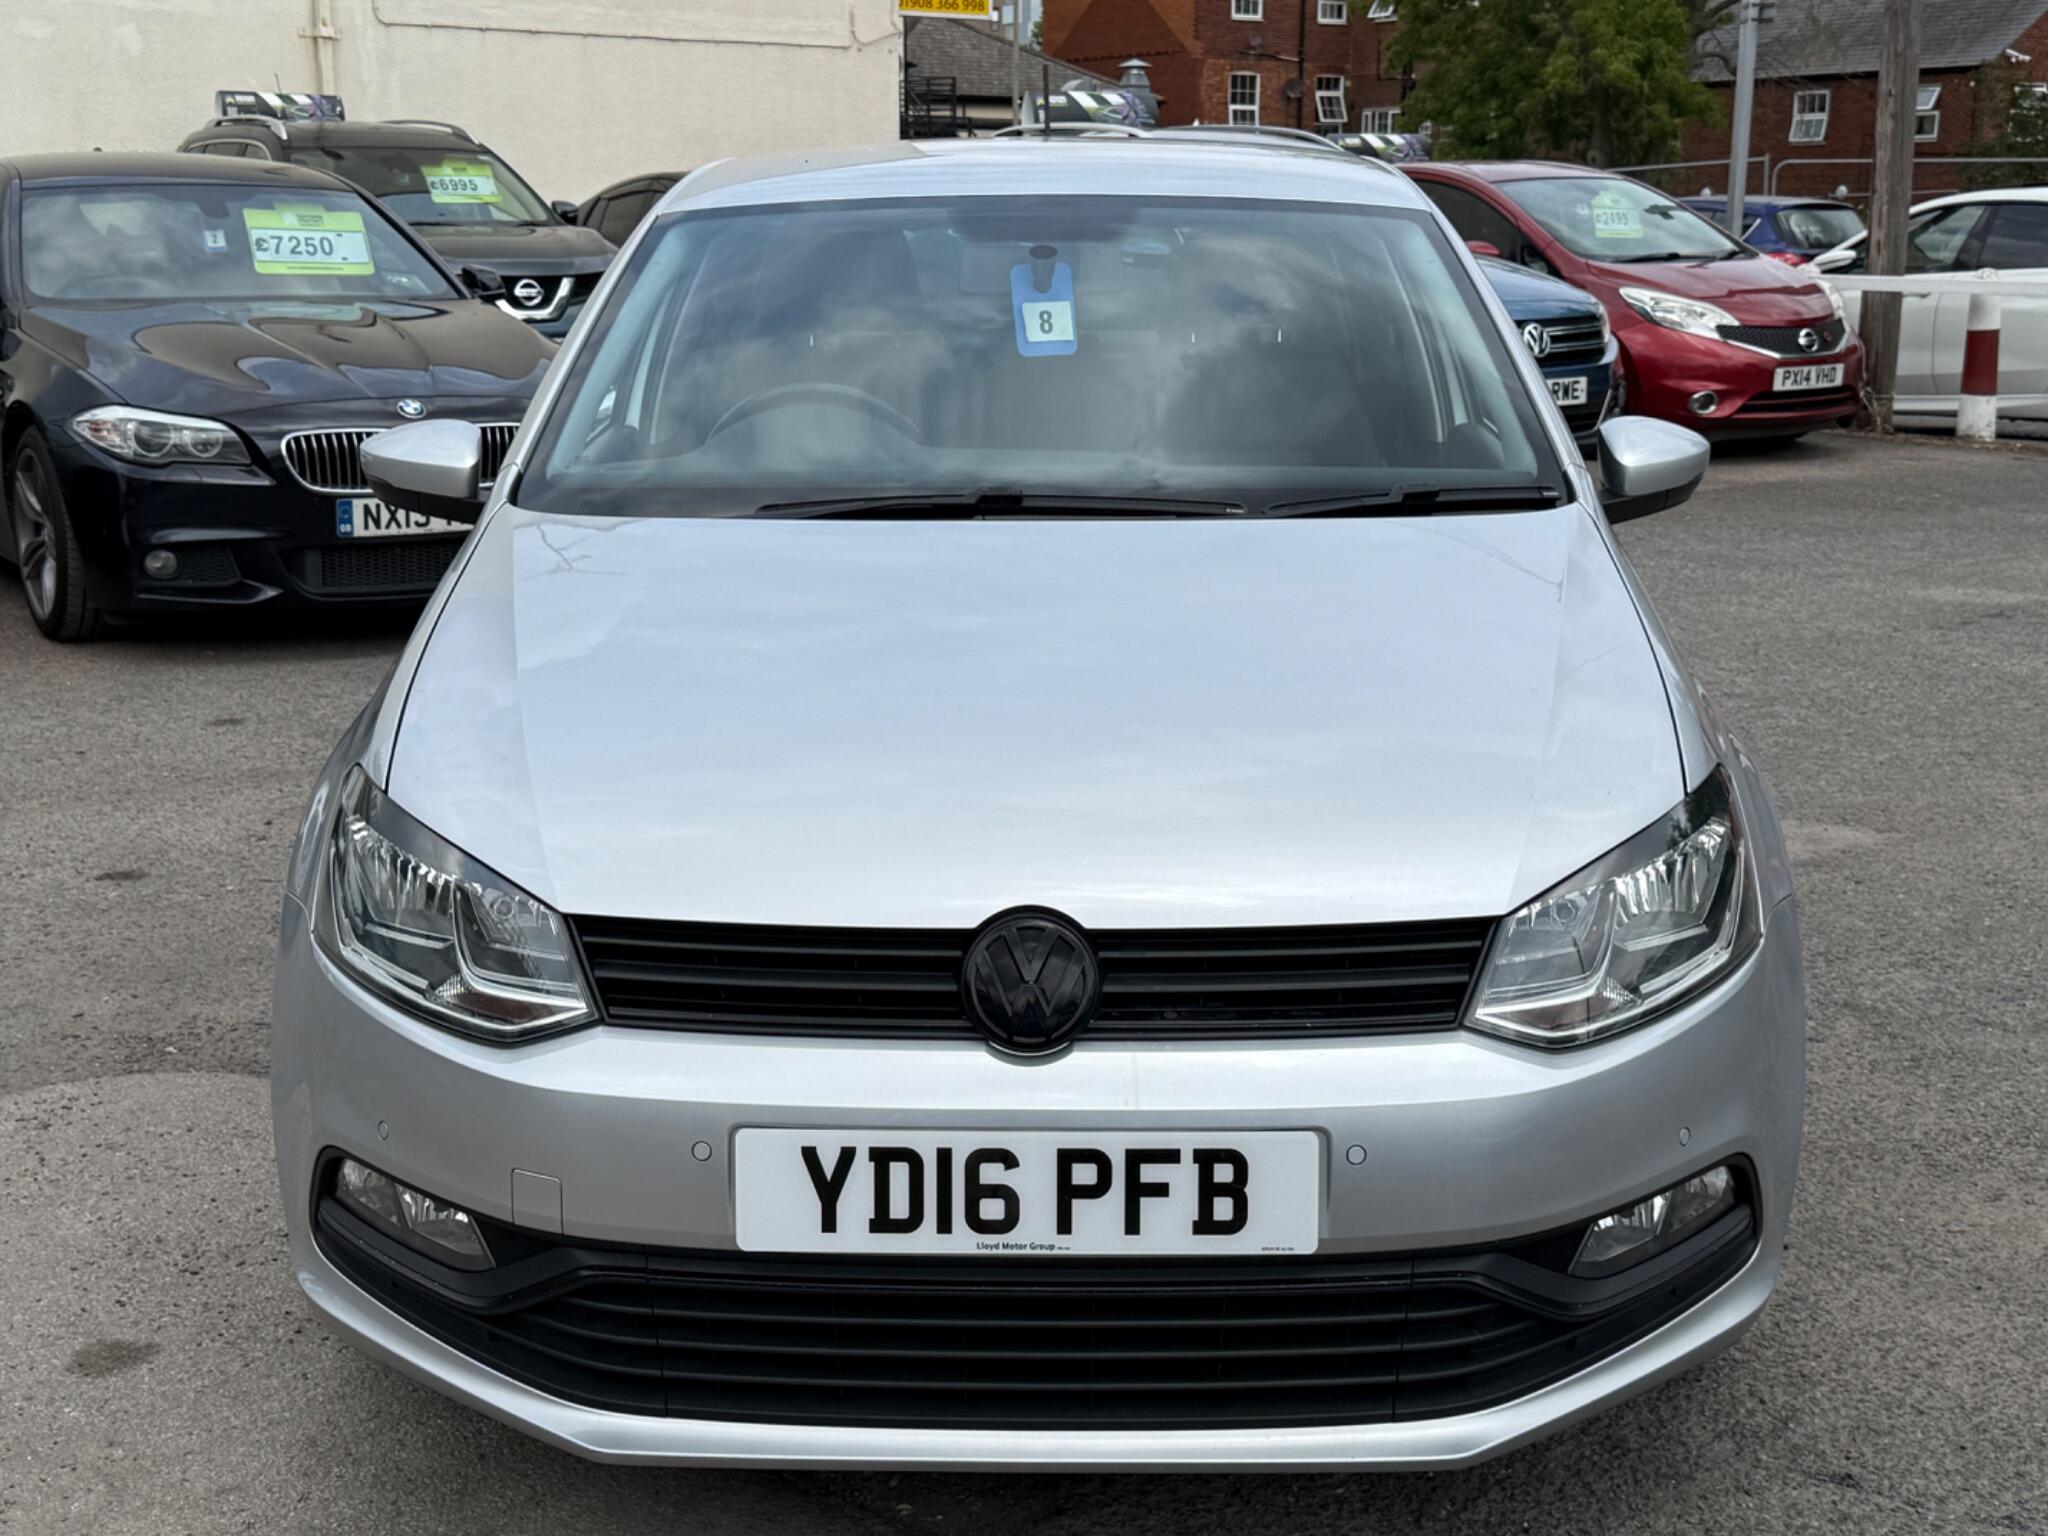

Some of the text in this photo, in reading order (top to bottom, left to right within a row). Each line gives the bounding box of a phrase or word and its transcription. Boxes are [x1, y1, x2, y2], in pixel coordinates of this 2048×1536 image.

[962, 0, 985, 12] 998
[254, 235, 333, 256] £7250
[1039, 310, 1053, 334] 8
[1781, 367, 1811, 387] PX14
[801, 1146, 1249, 1236] YD16 PFB
[976, 1242, 1000, 1251] Lloyd
[1002, 1242, 1028, 1250] Motor
[1029, 1242, 1056, 1252] Group
